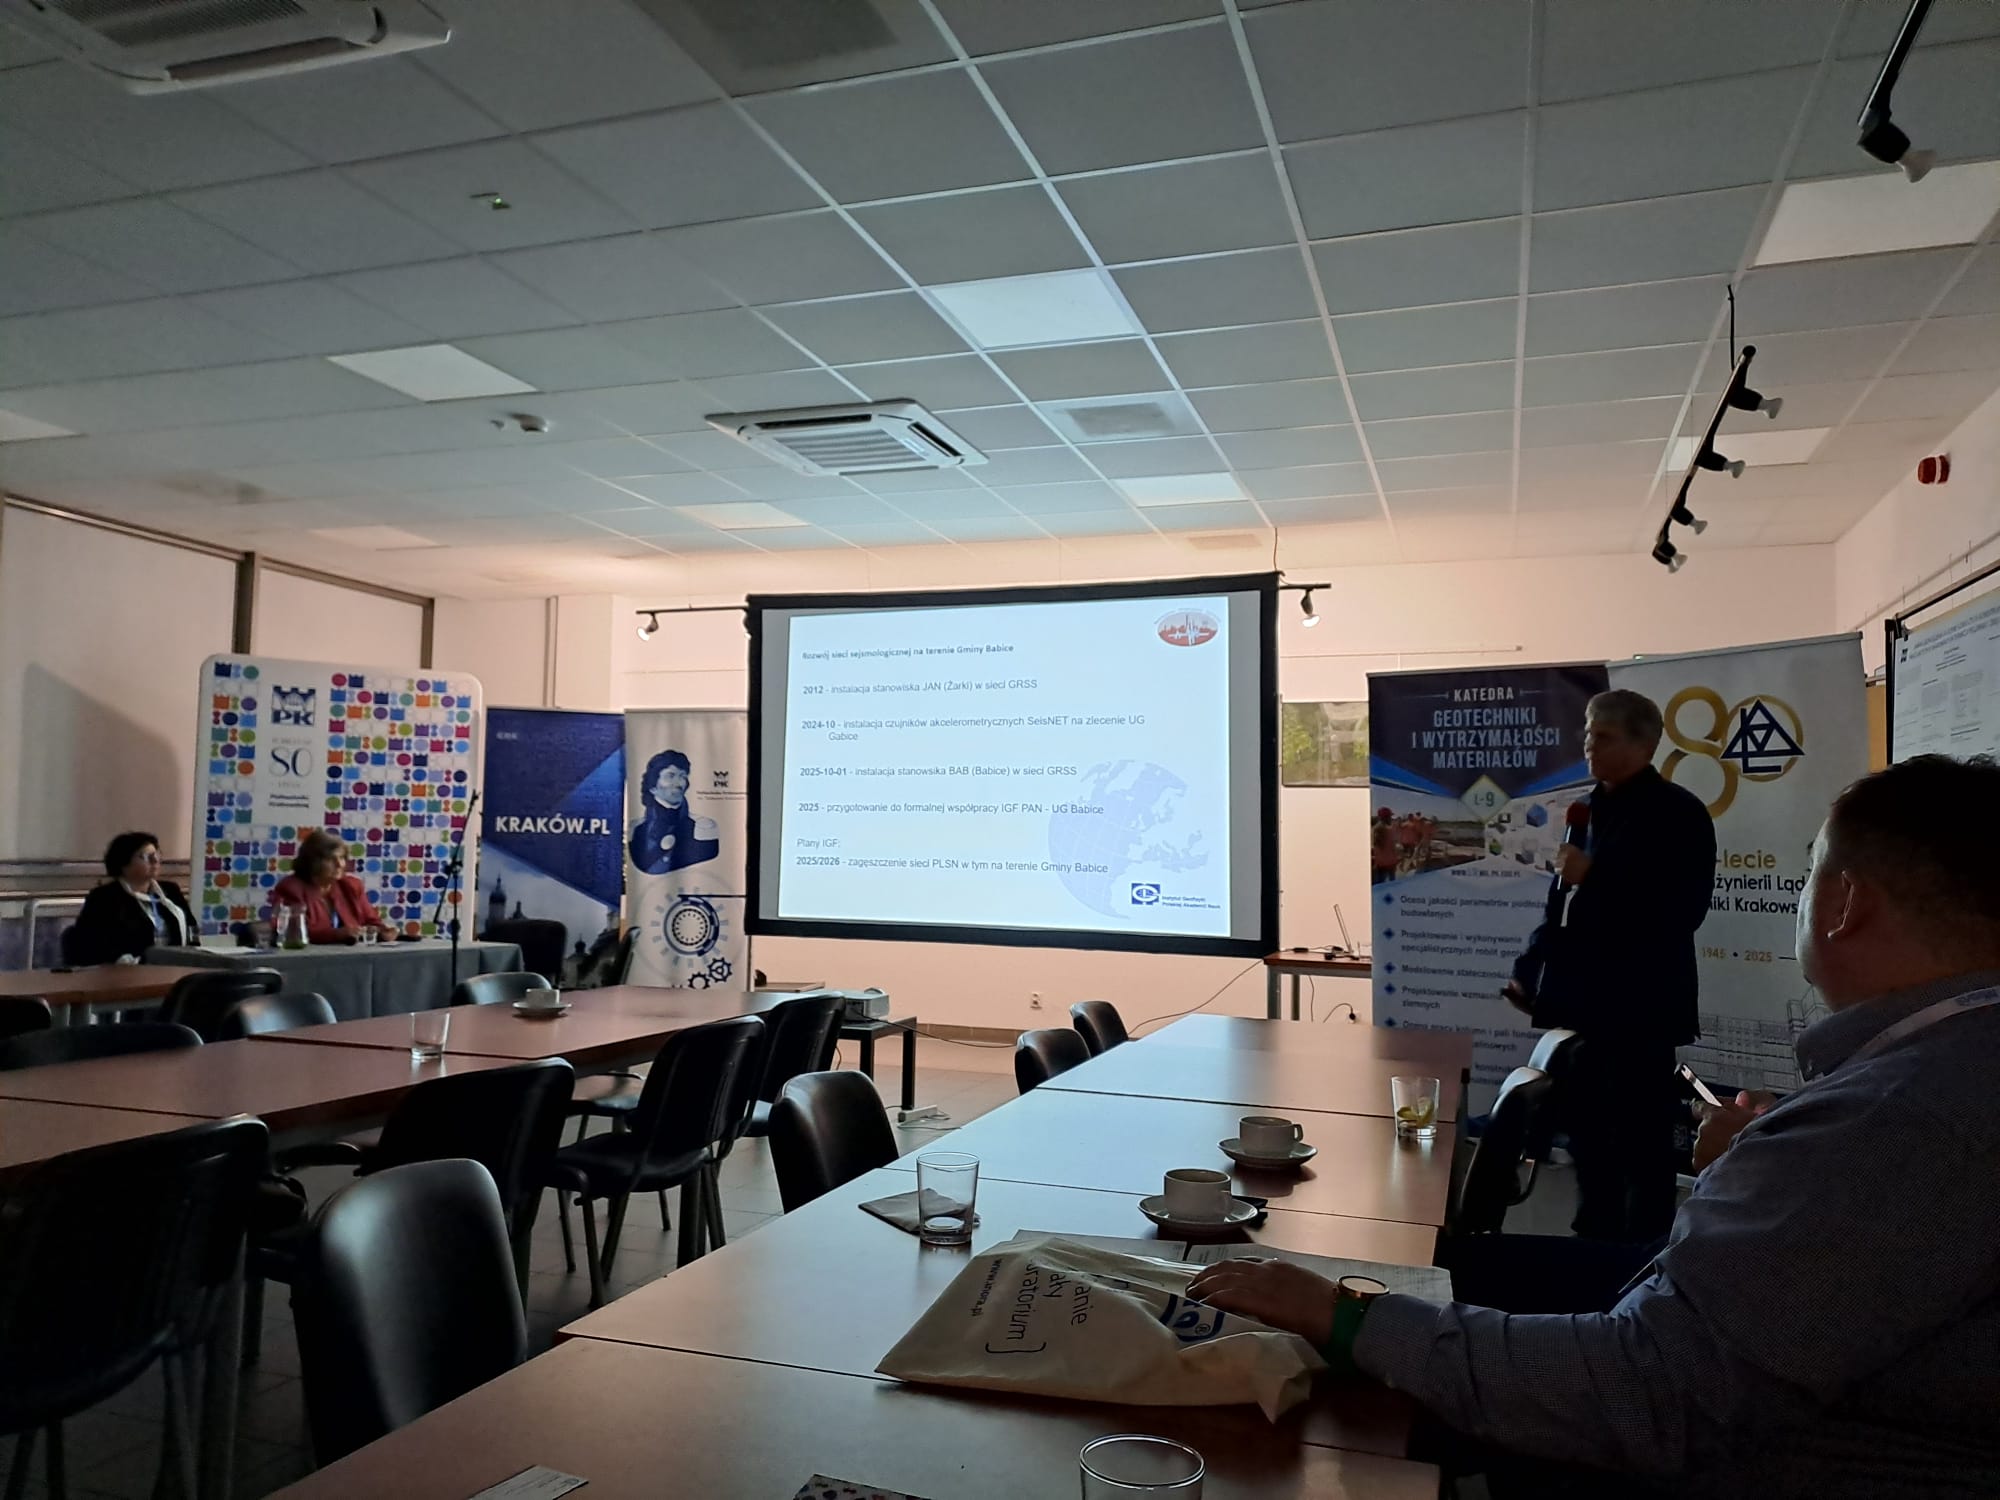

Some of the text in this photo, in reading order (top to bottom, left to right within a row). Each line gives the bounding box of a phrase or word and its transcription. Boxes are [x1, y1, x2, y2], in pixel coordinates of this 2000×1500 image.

[832, 650, 848, 659] sieci
[850, 648, 912, 659] sejsmologicznej
[913, 648, 923, 656] na
[926, 646, 955, 655] terenie
[957, 645, 983, 655] Gminy
[986, 643, 1014, 653] Babice
[803, 685, 824, 694] 2012
[831, 684, 870, 695] instalacja
[872, 683, 920, 693] stanowiska
[923, 682, 941, 691] JAN
[944, 679, 972, 692] (Żarki)
[975, 682, 982, 690] w
[985, 680, 1006, 690] sieci
[1008, 679, 1038, 689] GRSS
[1453, 686, 1515, 703] KATEDRA
[271, 709, 314, 726] PK
[801, 720, 835, 729] 2024-10
[843, 719, 882, 730] instalacja
[885, 718, 927, 729] czujników
[929, 716, 1024, 728] akcelerometrycznych
[1027, 715, 1068, 726] SeisNET
[1071, 717, 1083, 725] na
[1086, 715, 1126, 725] zlecenie
[1128, 715, 1145, 725] UG
[1433, 706, 1537, 728] GEOTECHNIKI
[1411, 724, 1560, 749] I WYTRZYMAŁOŚCI
[1432, 746, 1538, 769] MATERIAŁÓW
[800, 767, 847, 777] 2025-10-01
[855, 767, 895, 778] instalacja
[949, 766, 969, 775] BAB
[972, 765, 1010, 777] (Babice)
[1013, 767, 1020, 775] w
[1023, 766, 1044, 776] sieci
[1047, 766, 1077, 776] GRSS
[798, 802, 819, 812] 2025
[827, 803, 888, 814] przygotowanie
[890, 803, 901, 812] do
[903, 803, 945, 814] formalnej
[947, 803, 999, 815] współpracy
[1001, 804, 1018, 813] IGF
[1022, 804, 1042, 813] PAN
[1052, 804, 1068, 814] UG
[1071, 804, 1104, 814] Babice
[495, 812, 611, 835] KRAKÓW.PL
[796, 838, 820, 849] Plany
[796, 856, 840, 866] 2025/2026
[848, 858, 907, 868] zagęszczenie
[909, 858, 930, 868] sieci
[932, 858, 958, 869] PLSN
[961, 861, 968, 869] w
[971, 861, 988, 871] tym
[991, 862, 1003, 870] na
[1005, 861, 1038, 871] terenie
[1041, 861, 1071, 873] Gminy
[1074, 862, 1108, 873] Babice
[1714, 873, 1771, 892] żynierii
[1428, 895, 1457, 906] jakości
[1459, 897, 1509, 908] parametrów
[1735, 896, 1799, 914] Krakows
[1400, 908, 1454, 920] budowlanych
[1401, 929, 1457, 943] Projektowanie
[1401, 943, 1473, 956] specjalistycznych
[1701, 946, 1773, 962] 1945 2025
[1402, 985, 1459, 999] Projektowanie
